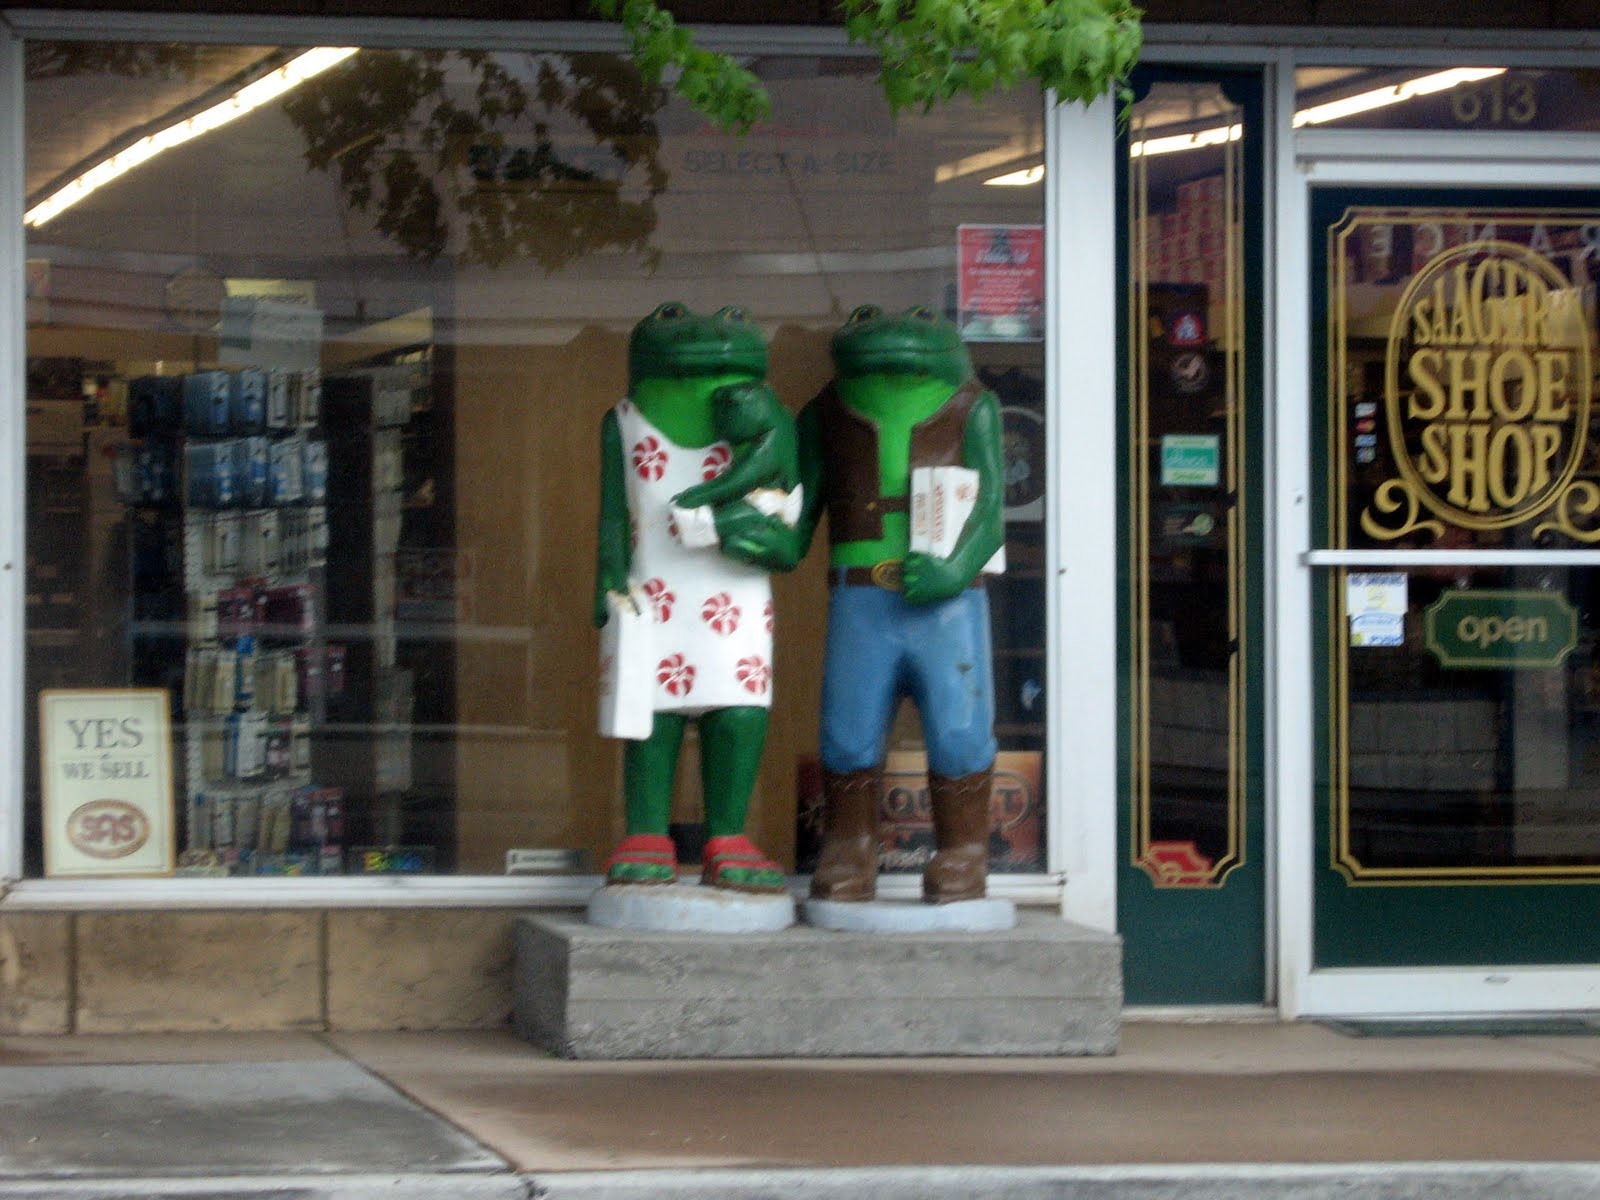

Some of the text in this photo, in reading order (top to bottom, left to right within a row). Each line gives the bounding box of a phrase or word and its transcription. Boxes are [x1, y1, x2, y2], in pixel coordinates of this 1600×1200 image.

[1408, 347, 1571, 421] SHOE
[1418, 422, 1563, 513] SHOP
[1457, 614, 1549, 649] open
[66, 717, 144, 749] YES
[62, 760, 150, 780] WE SELL
